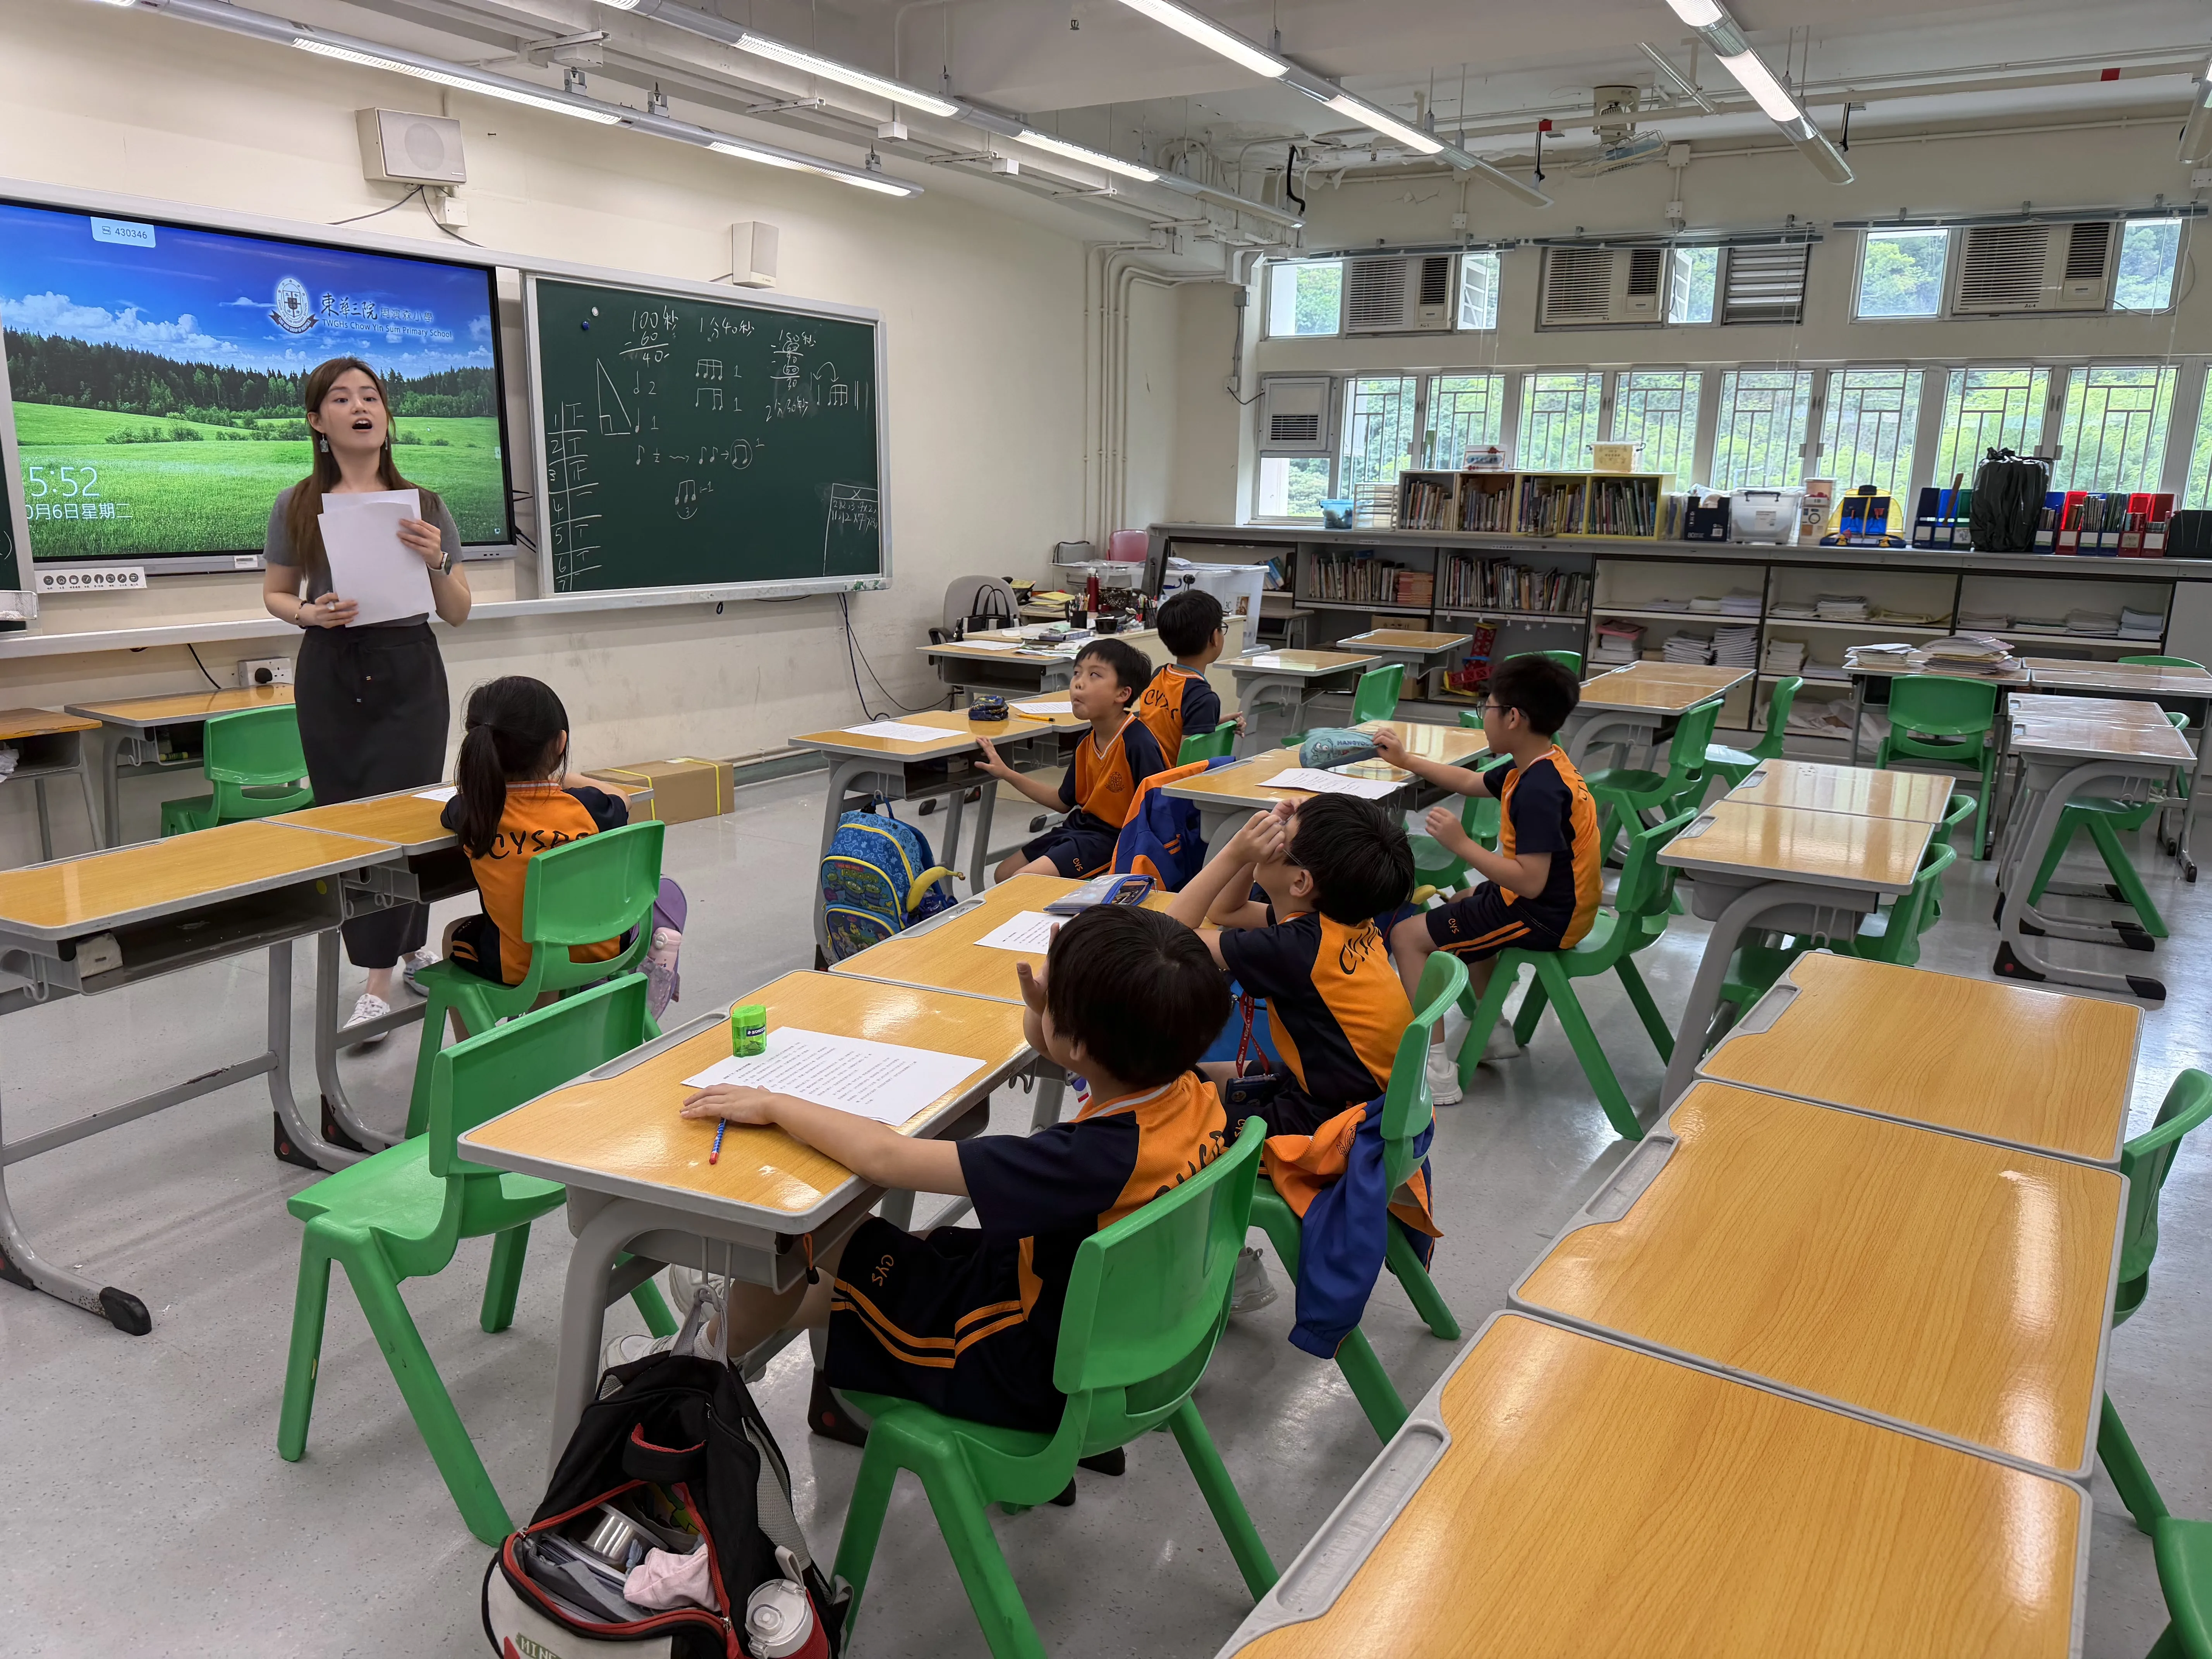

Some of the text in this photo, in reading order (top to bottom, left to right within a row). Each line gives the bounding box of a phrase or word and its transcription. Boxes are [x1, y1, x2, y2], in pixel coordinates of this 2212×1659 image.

[115, 228, 147, 239] 430346
[321, 293, 378, 320] 東華三院
[322, 319, 348, 328] TWGHs
[350, 322, 370, 330] Chow
[386, 325, 400, 333] Sum
[403, 327, 428, 338] Primary
[430, 329, 452, 338] School
[648, 381, 657, 395] 2
[551, 440, 563, 454] 2
[553, 498, 564, 520] 4
[555, 527, 563, 545] 5
[558, 556, 567, 573] 6
[1073, 858, 1083, 871] CYS
[1448, 918, 1459, 934] CYS
[871, 1254, 894, 1286] CYS
